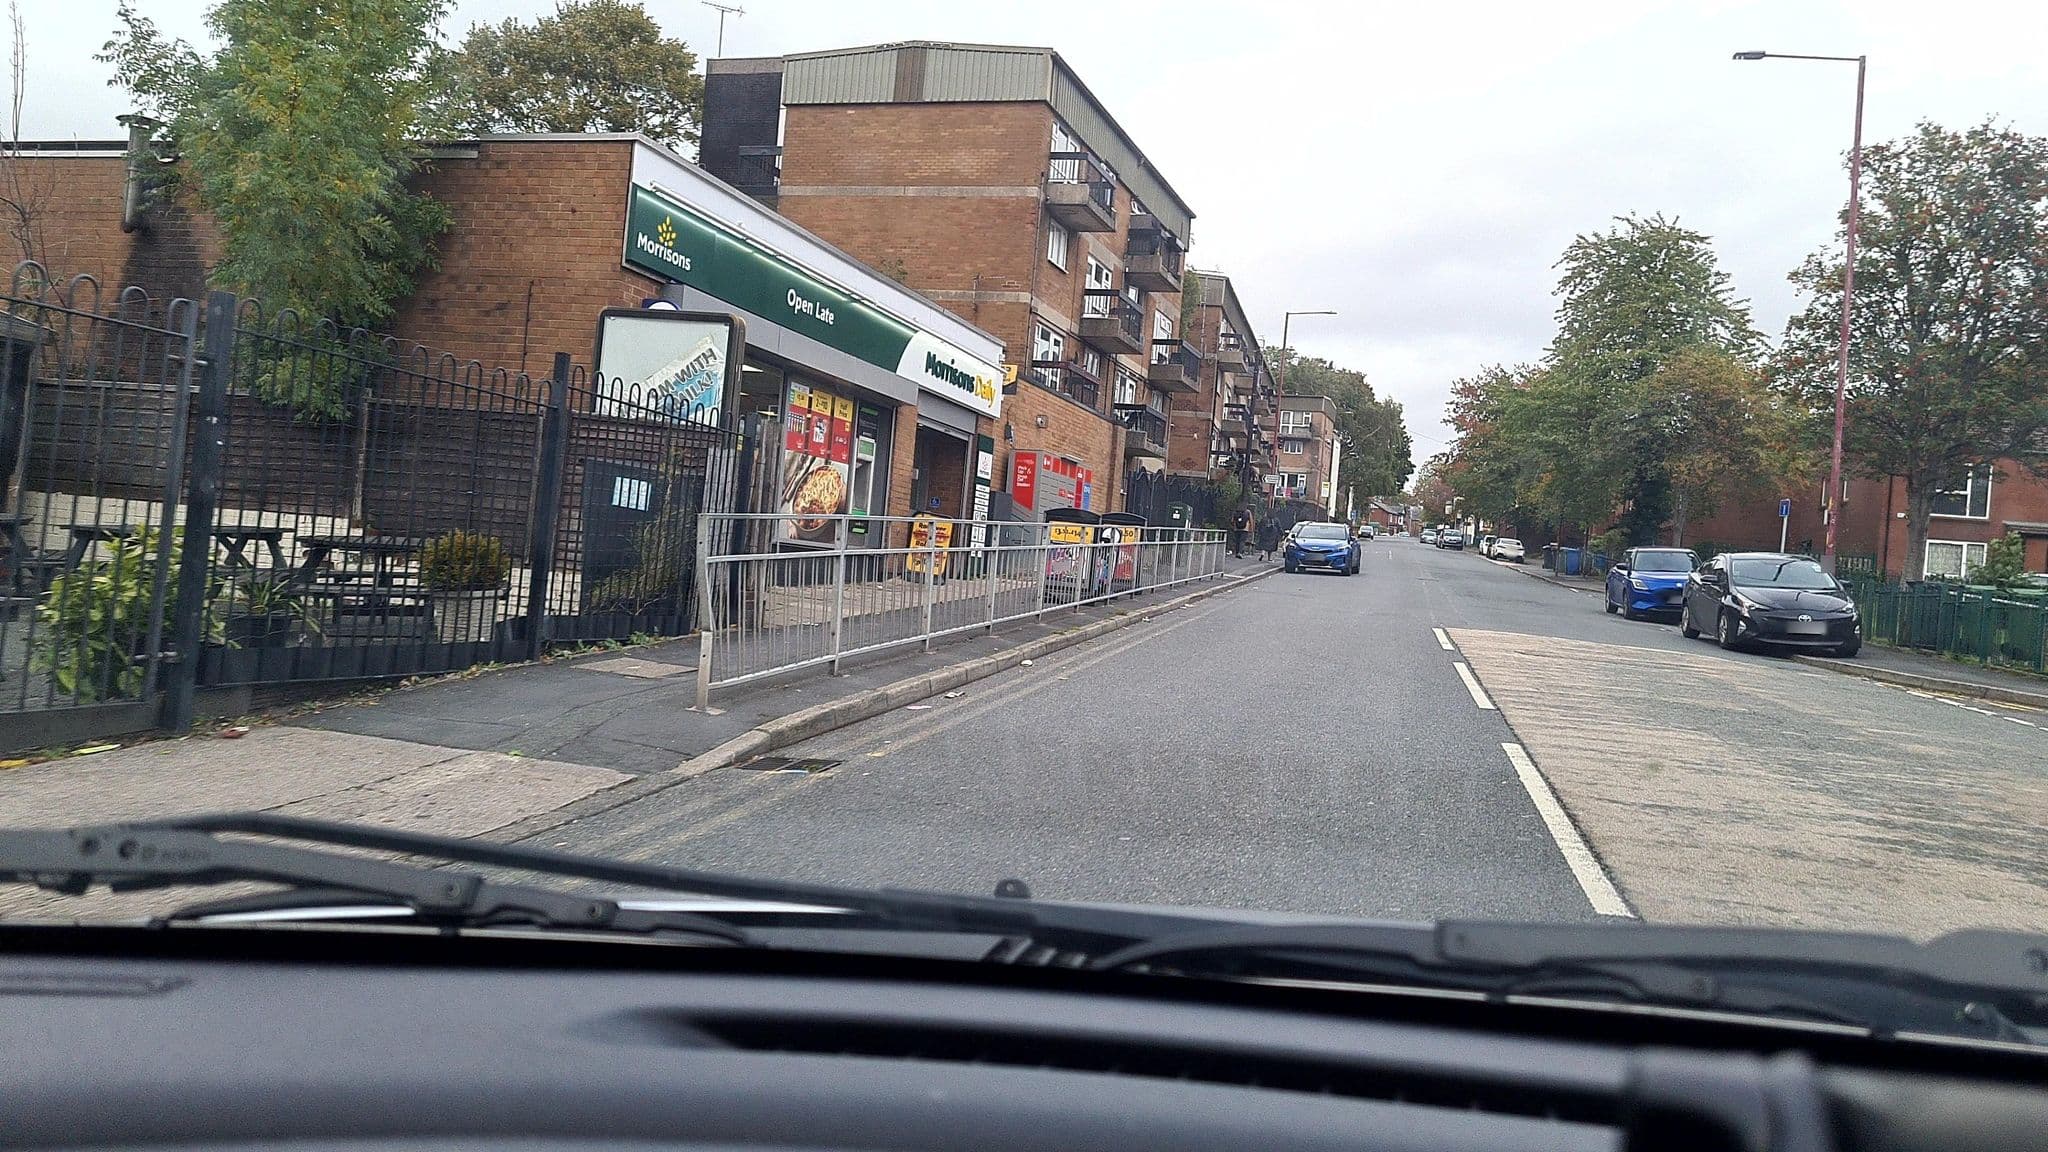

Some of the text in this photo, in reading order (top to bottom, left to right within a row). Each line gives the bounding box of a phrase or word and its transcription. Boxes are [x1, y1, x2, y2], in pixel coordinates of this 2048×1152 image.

[637, 231, 691, 271] Morrisons
[787, 288, 835, 325] Open Late
[674, 347, 717, 384] WITH
[925, 351, 975, 394] Morrisons
[974, 375, 996, 408] Daily
